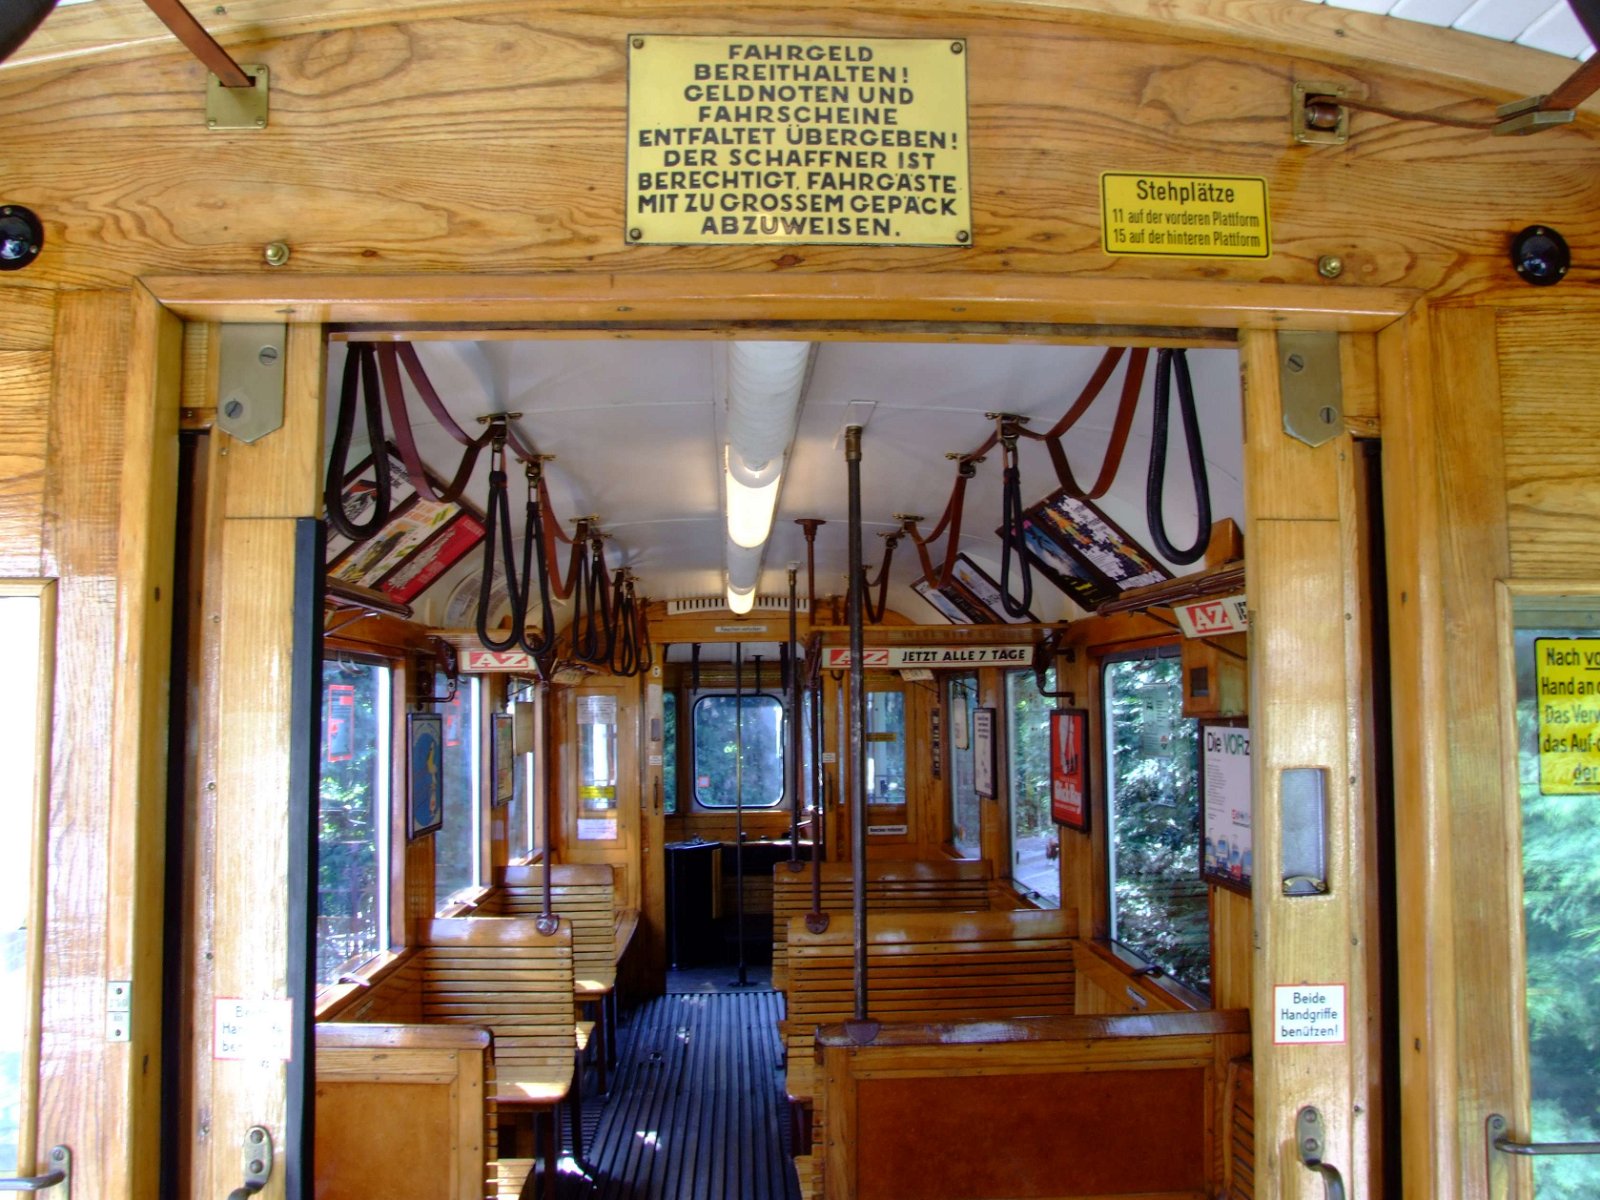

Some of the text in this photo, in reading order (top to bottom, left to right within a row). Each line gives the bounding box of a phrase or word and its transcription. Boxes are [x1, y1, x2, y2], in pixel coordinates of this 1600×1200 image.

[728, 44, 873, 62] FAHRGELD
[694, 64, 909, 83] BEREITHALTEN!
[683, 84, 914, 105] GELDNOTEN UND
[698, 105, 898, 125] FAHRSCHEINE
[639, 123, 958, 150] ENTFALTET ÜBERGEBEN!
[664, 149, 935, 170] DER SCHAFFNER IST
[807, 171, 957, 194] FAHRGÄSTE
[1136, 179, 1235, 205] Stehplätze
[638, 193, 957, 216] MIT ZU GROSSEM GEPÄCK
[700, 216, 901, 237] ABZUWEISEN.
[1112, 208, 1259, 227] 11 auf der vorderen Plattform
[1113, 228, 1261, 247] 15 auf der hinteren Plattform
[470, 652, 529, 668] AZ
[902, 651, 938, 662] JETZT
[942, 650, 974, 661] ALLE
[978, 650, 986, 661] 7
[992, 650, 1025, 660] TAGE
[1546, 647, 1580, 666] Nach
[1541, 676, 1575, 695] Hand
[1578, 681, 1594, 695] an
[1545, 705, 1570, 724] Das
[1207, 732, 1221, 753] Die
[1543, 733, 1567, 753] das
[1574, 762, 1598, 781] der
[1293, 991, 1326, 1004] Beide
[1281, 1007, 1338, 1023] Handgriffe
[1281, 1024, 1338, 1037] benützen!
